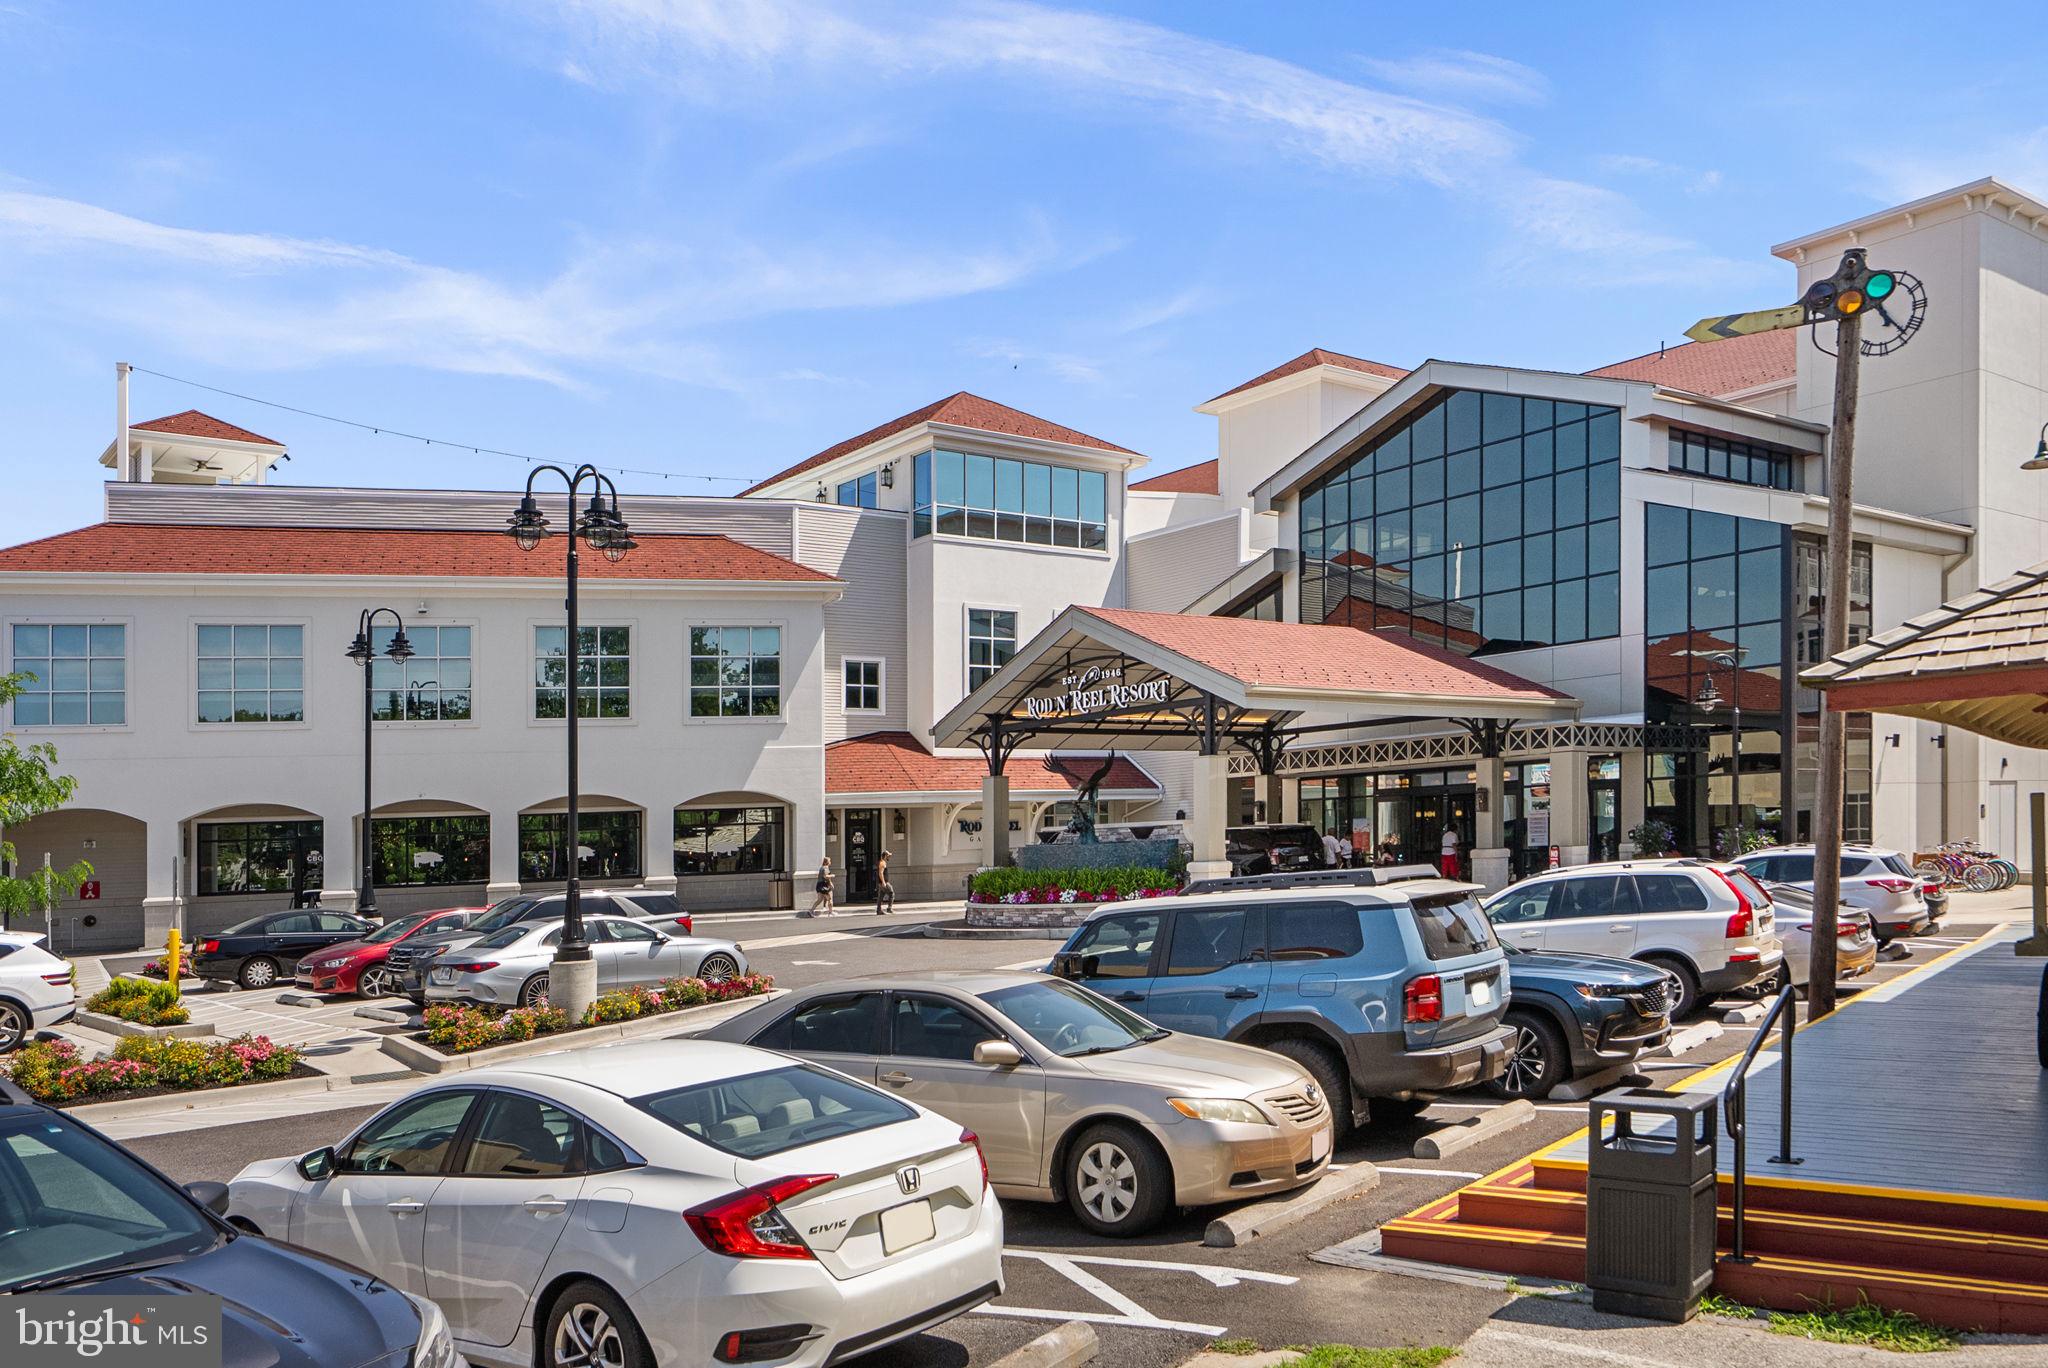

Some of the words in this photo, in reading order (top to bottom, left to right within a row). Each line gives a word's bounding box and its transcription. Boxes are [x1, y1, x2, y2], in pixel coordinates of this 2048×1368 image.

[1101, 668, 1121, 679] 1946
[1024, 697, 1052, 720] ROD
[1069, 688, 1107, 713] REEL
[1107, 679, 1169, 709] RESORT
[957, 819, 982, 835] ROD
[809, 1219, 847, 1235] CIVIC
